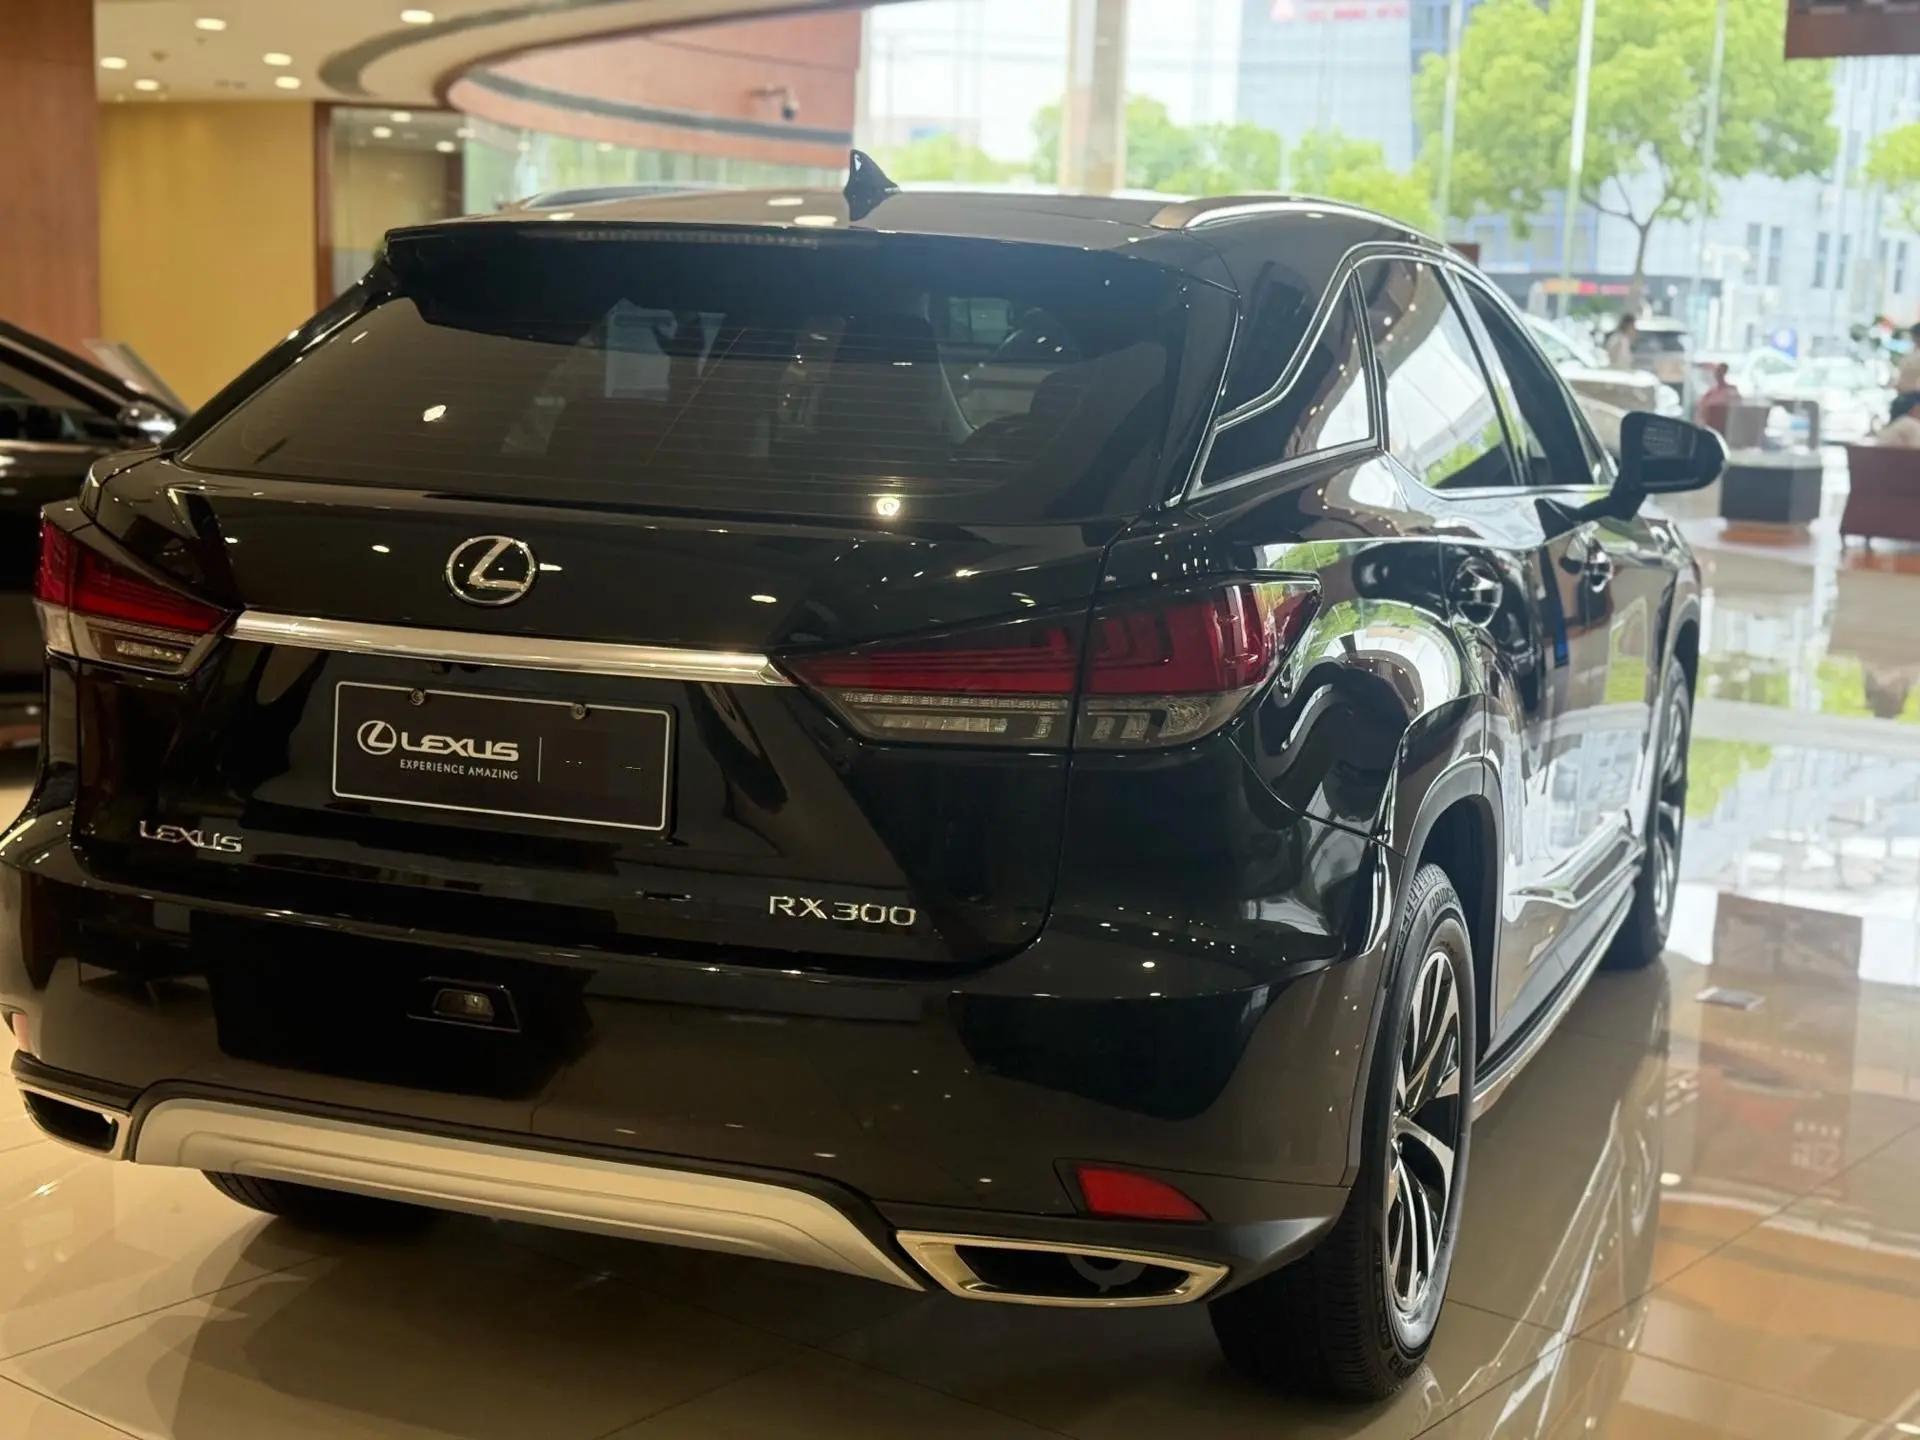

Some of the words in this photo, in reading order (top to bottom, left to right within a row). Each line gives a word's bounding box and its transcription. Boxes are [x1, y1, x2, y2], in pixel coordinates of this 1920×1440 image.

[401, 731, 519, 762] LEXUS
[400, 758, 465, 775] EXPERIENCE
[468, 766, 519, 781] AMAZING
[140, 820, 243, 852] LEXUS
